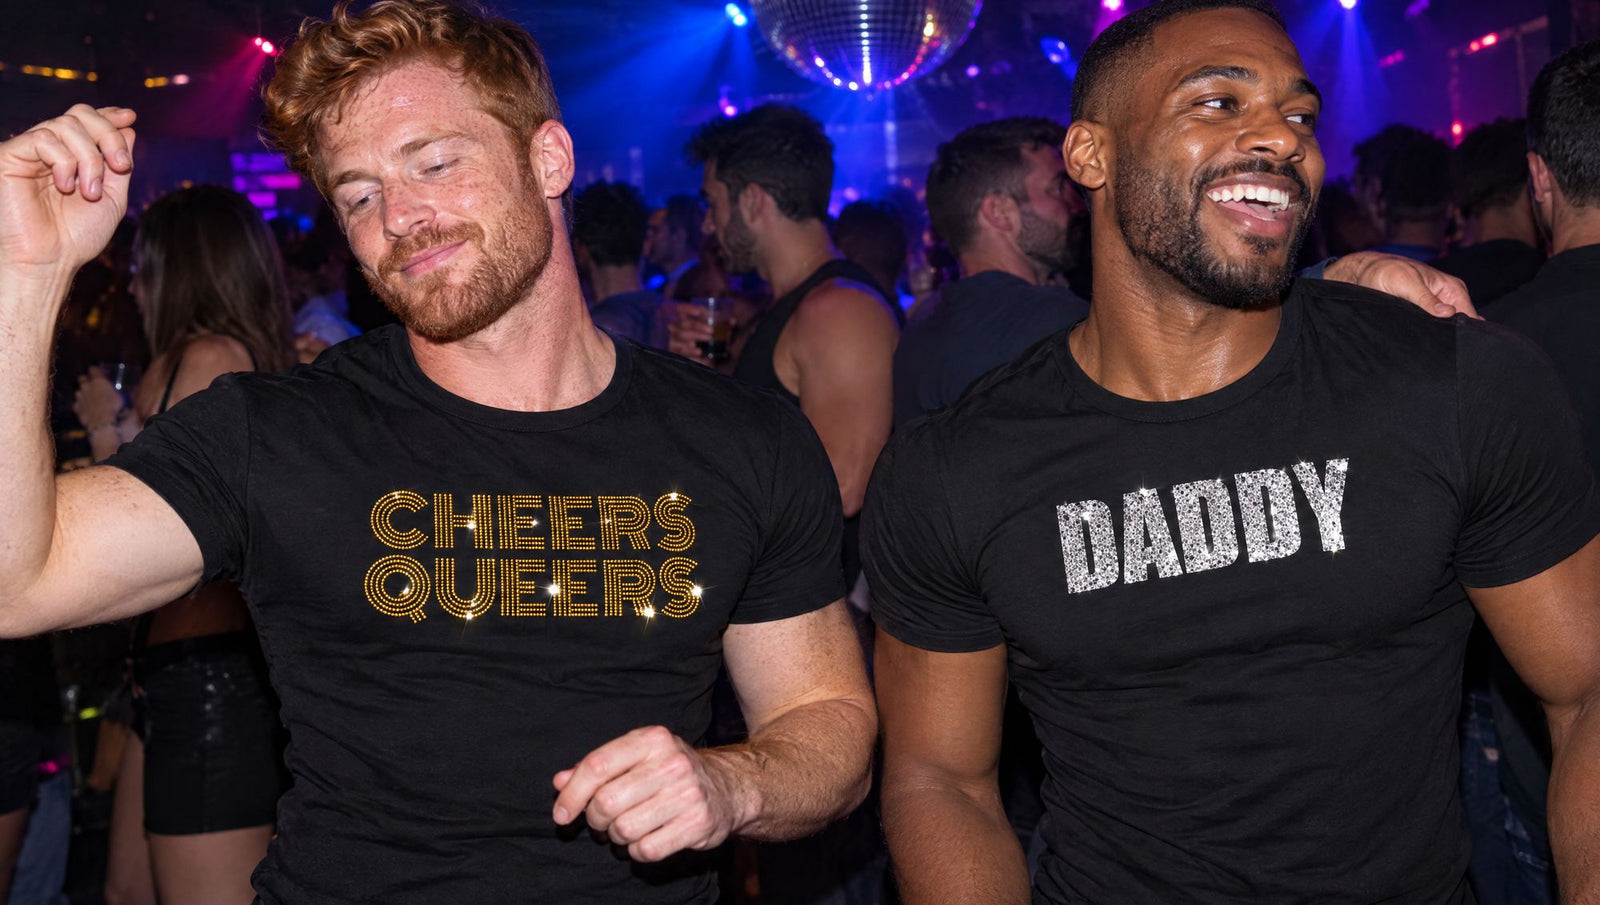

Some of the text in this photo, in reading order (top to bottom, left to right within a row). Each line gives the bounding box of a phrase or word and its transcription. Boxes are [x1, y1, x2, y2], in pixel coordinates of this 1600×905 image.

[370, 490, 696, 552] CHEERS
[1056, 458, 1350, 595] DADDY
[364, 554, 702, 624] QUEERS
